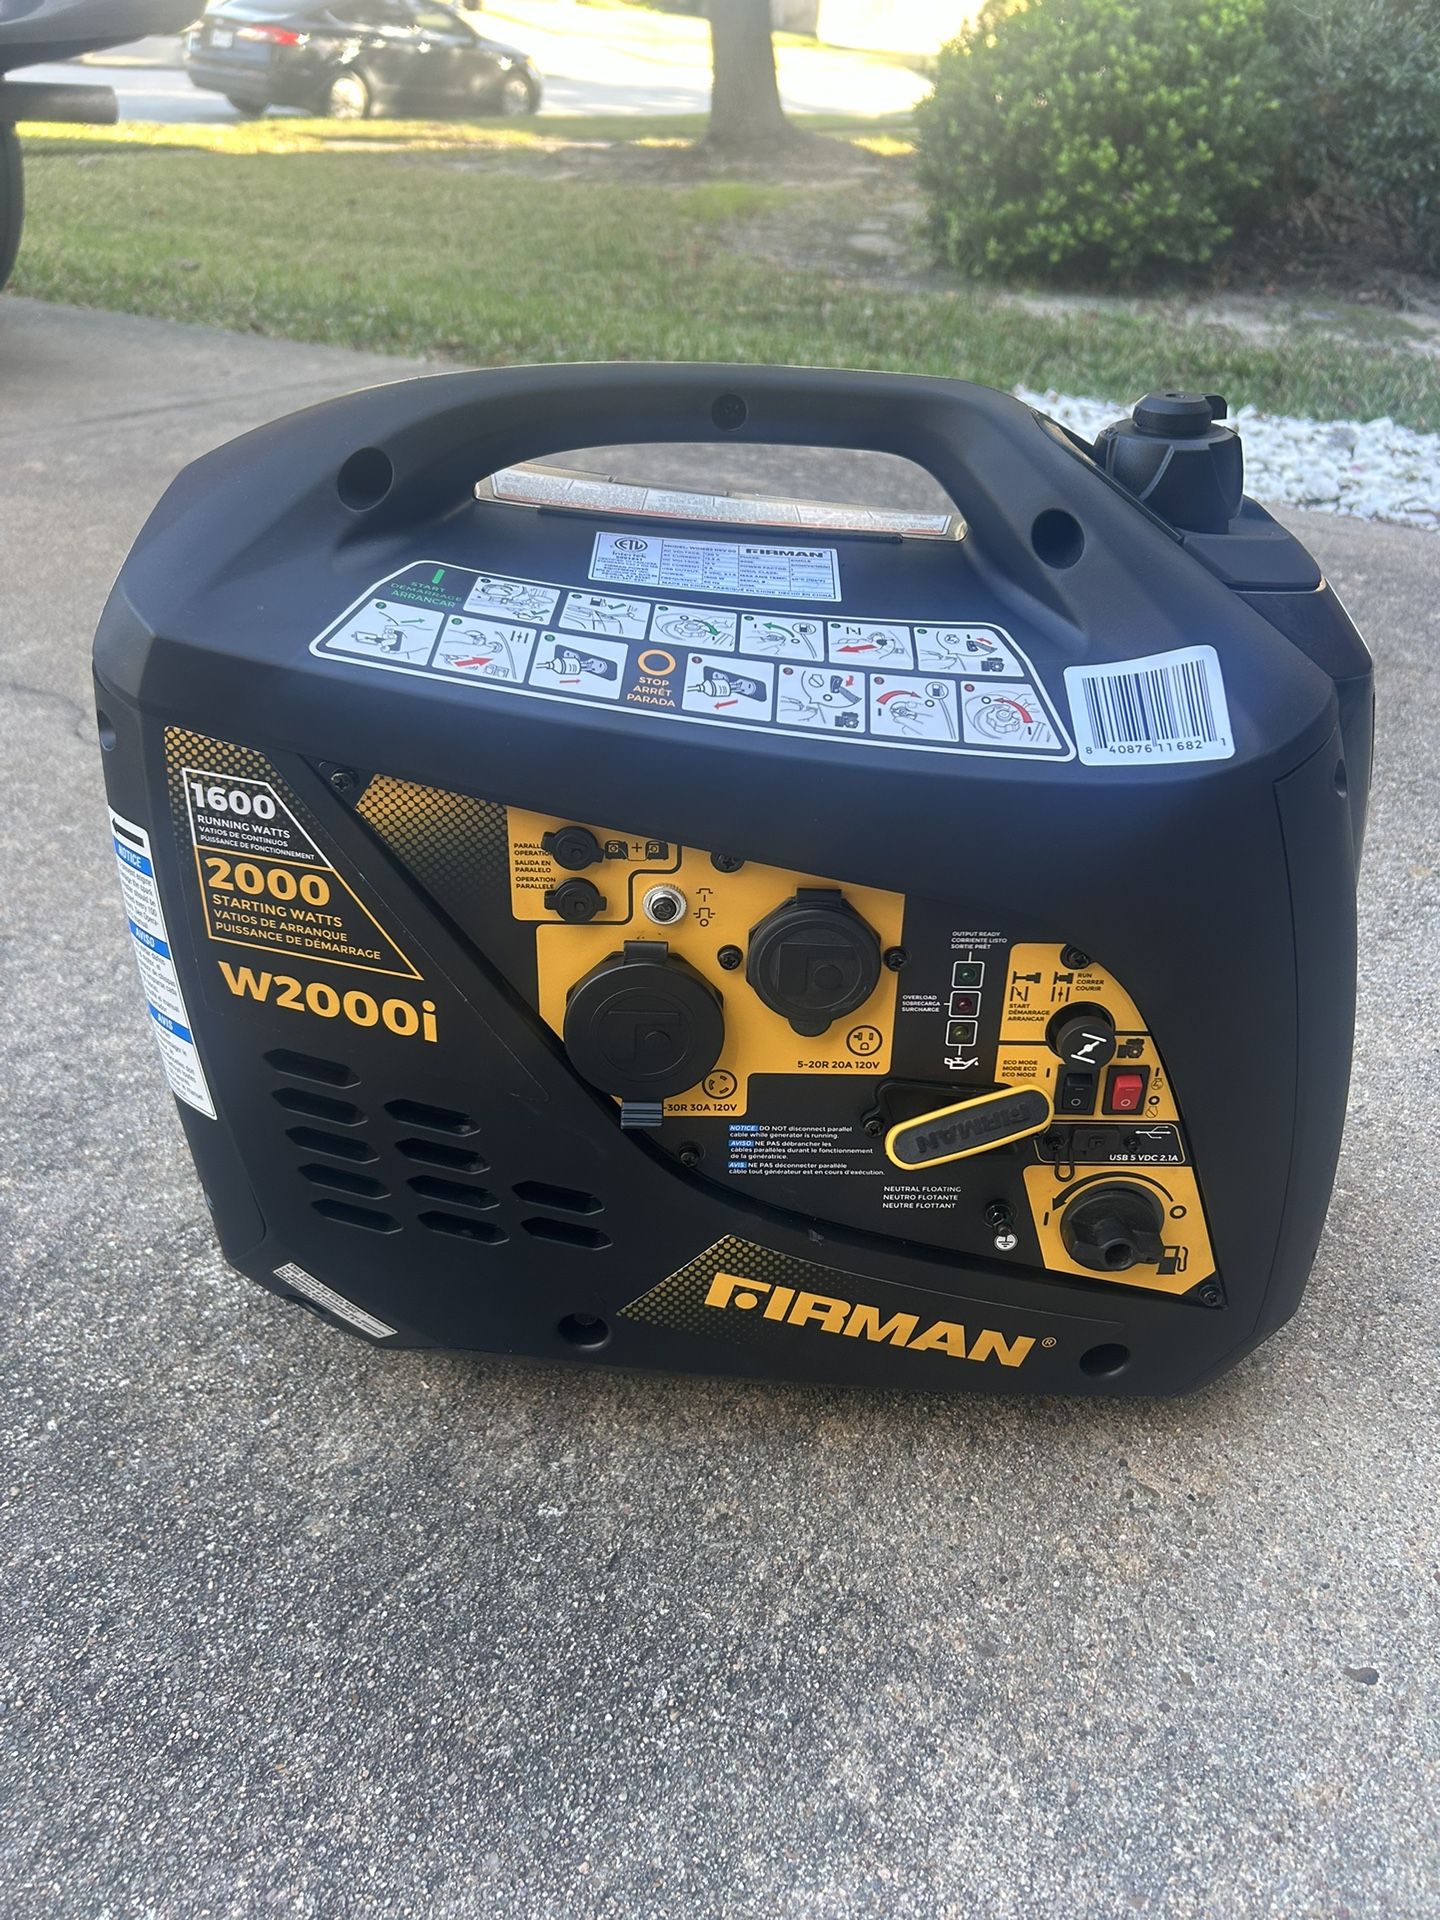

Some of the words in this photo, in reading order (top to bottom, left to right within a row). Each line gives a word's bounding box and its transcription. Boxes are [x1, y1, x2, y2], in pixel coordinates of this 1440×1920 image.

[745, 548, 824, 558] FIRMAN
[411, 581, 445, 593] START
[391, 590, 456, 608] ARRANCAR
[632, 684, 673, 697] ARRÊT
[639, 676, 670, 686] STOP
[626, 692, 676, 707] PARADA
[1086, 747, 1093, 755] 8
[1109, 744, 1152, 754] 40876
[1157, 739, 1203, 752] 11682
[1220, 737, 1227, 747] 1
[190, 782, 276, 820] 1600
[197, 814, 250, 832] RUNNING
[251, 823, 291, 839] WATTS
[198, 826, 228, 837] VATIOS
[228, 831, 240, 840] DE
[240, 833, 289, 847] CONTINUOS
[118, 842, 142, 869] NOTICE
[200, 834, 239, 848] PUISSANCE
[239, 841, 250, 850] DE
[250, 844, 315, 861] FONCTIONNEMENT
[204, 857, 331, 907] 2000
[212, 893, 287, 918] STARTING
[289, 908, 343, 928] WATTS
[213, 908, 258, 926] VATIOS
[260, 918, 277, 930] DE
[279, 922, 348, 942] ARRANQUE
[215, 921, 283, 942] PUISSANCE
[285, 935, 302, 946] DE
[305, 937, 382, 961] DÉMARRAGE
[217, 959, 438, 1043] W2000i
[157, 1012, 174, 1032] AVIS
[797, 1060, 830, 1069] 5-20R
[831, 1061, 853, 1069] 20A
[854, 1060, 881, 1070] 120V
[690, 1103, 711, 1112] 30A
[713, 1103, 738, 1112] 120V
[811, 1132, 839, 1140] running.
[1109, 1153, 1128, 1161] USB
[1138, 1154, 1159, 1162] VDC
[1159, 1154, 1179, 1162] 2.1A
[763, 1168, 801, 1176] générateur
[704, 1272, 1037, 1368] FIRMAN
